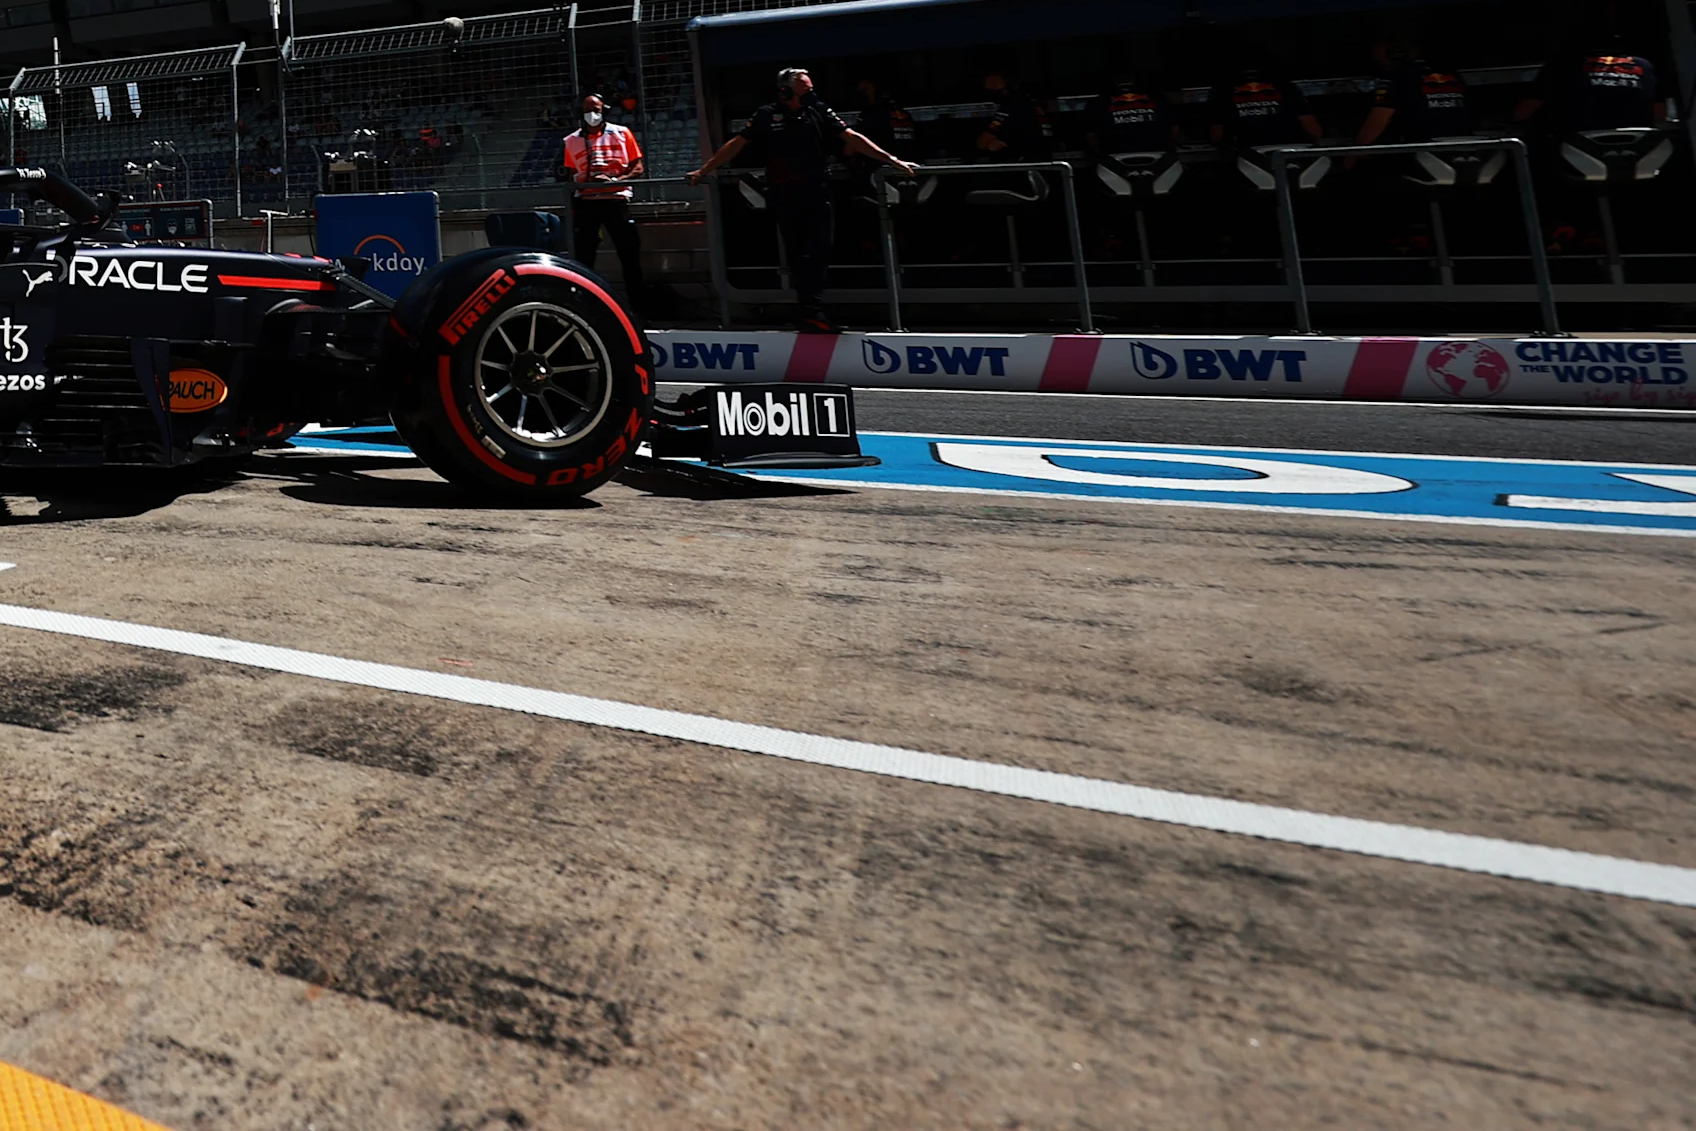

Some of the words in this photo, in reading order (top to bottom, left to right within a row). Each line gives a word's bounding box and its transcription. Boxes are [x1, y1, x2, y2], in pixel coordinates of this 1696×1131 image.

[329, 252, 426, 276] kday
[437, 267, 518, 347] PIRELLI
[672, 342, 760, 371] BWT
[908, 345, 1010, 377] BWT
[1184, 348, 1308, 383] BWT
[1515, 342, 1684, 364] CHANGE
[633, 363, 649, 396] P
[1522, 364, 1550, 374] THE
[1551, 365, 1689, 385] WORLD
[716, 391, 811, 437] Mobil
[545, 406, 644, 487] ZERO
